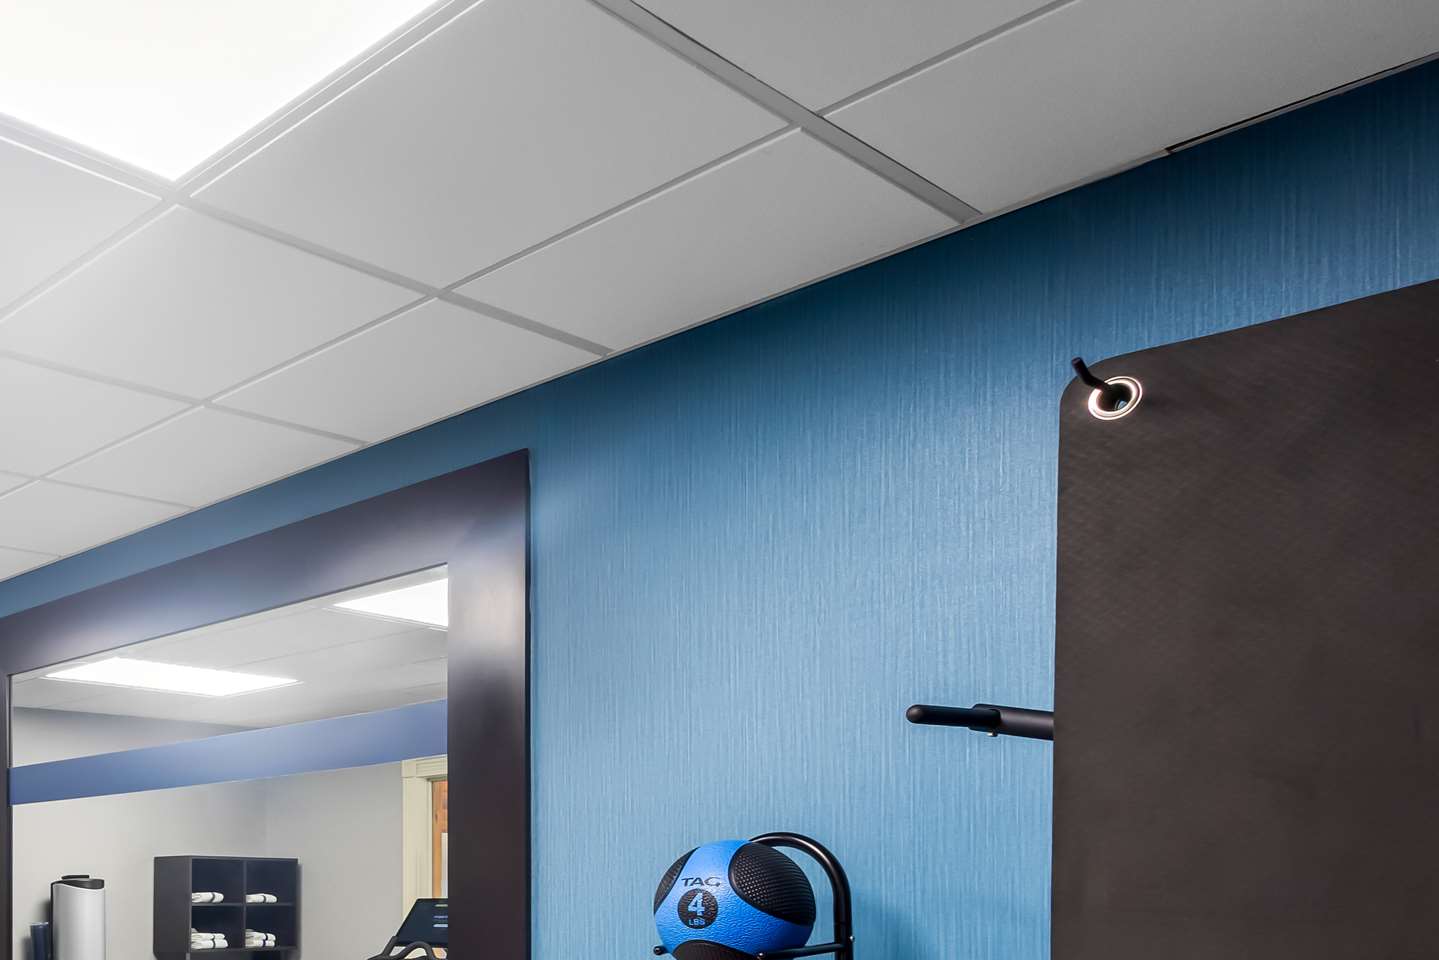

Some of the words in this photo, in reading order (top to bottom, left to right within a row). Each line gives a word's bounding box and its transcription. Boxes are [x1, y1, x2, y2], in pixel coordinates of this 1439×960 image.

[681, 876, 721, 887] TAG
[688, 892, 705, 916] 4
[688, 918, 706, 926] LBS
